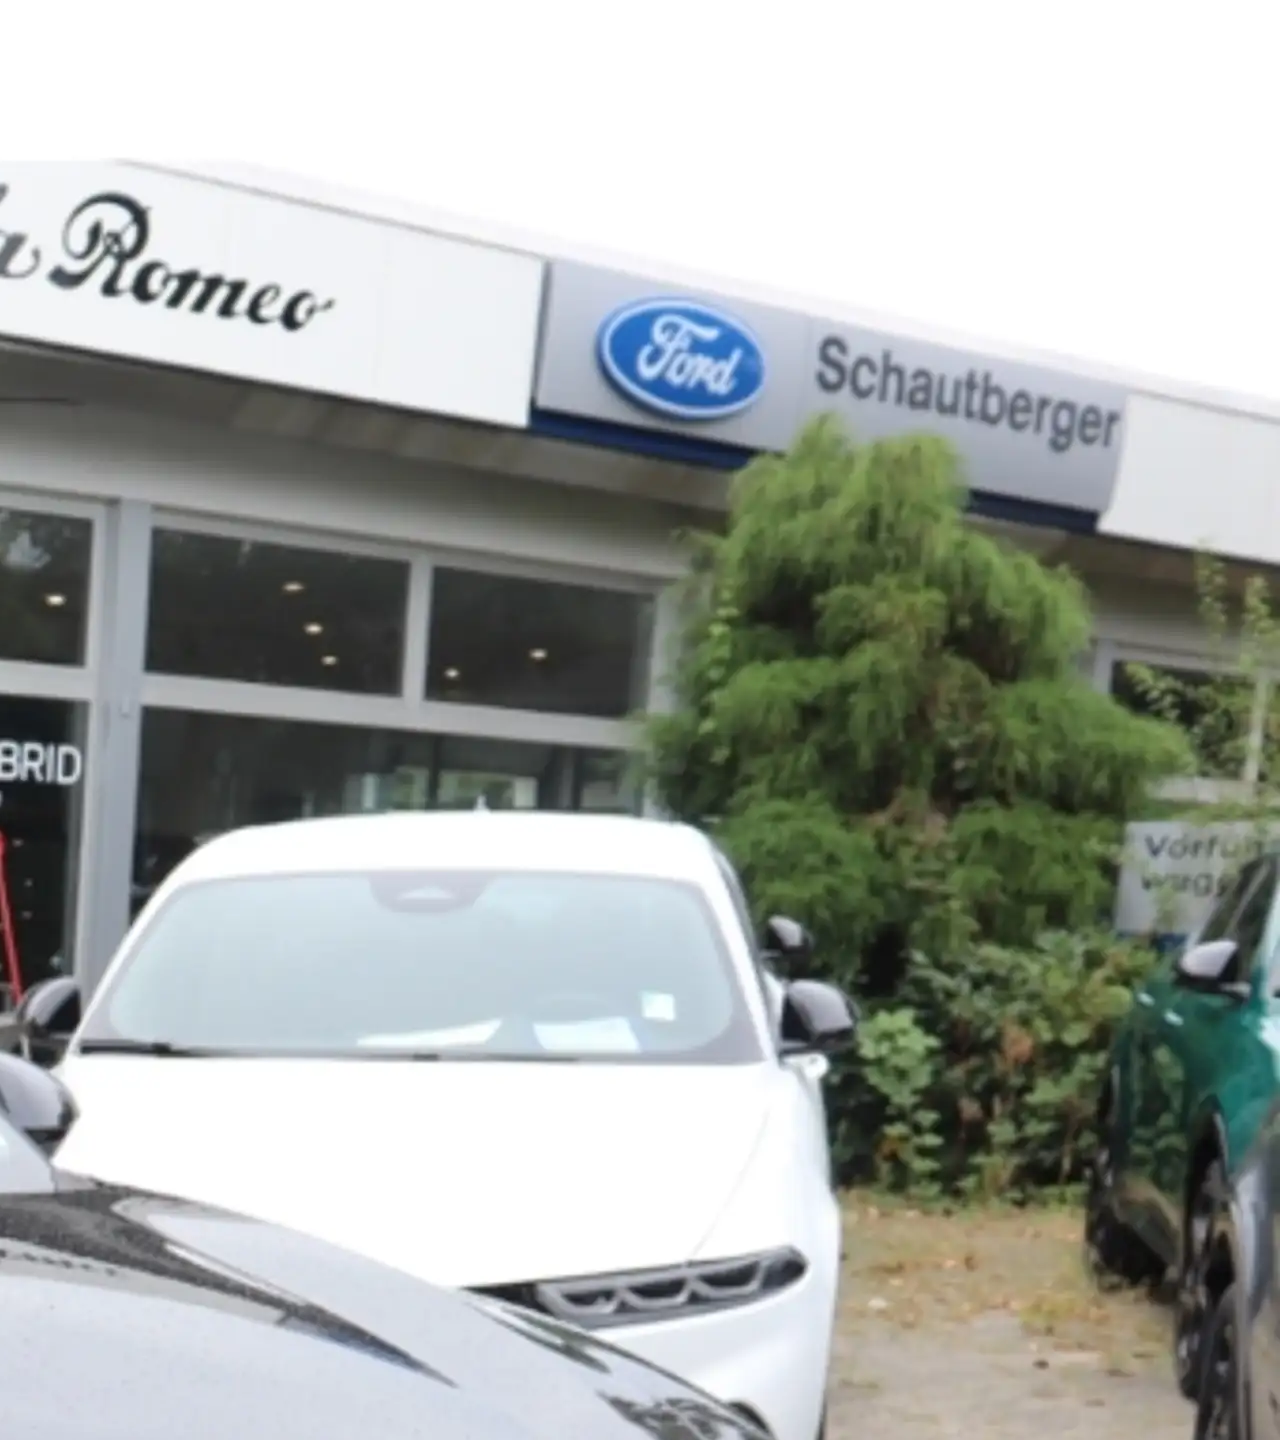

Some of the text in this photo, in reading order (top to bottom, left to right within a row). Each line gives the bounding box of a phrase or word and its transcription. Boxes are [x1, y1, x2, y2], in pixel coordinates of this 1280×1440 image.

[46, 191, 336, 332] Romeo
[637, 314, 743, 396] Ford
[815, 335, 1121, 453] Schautberger
